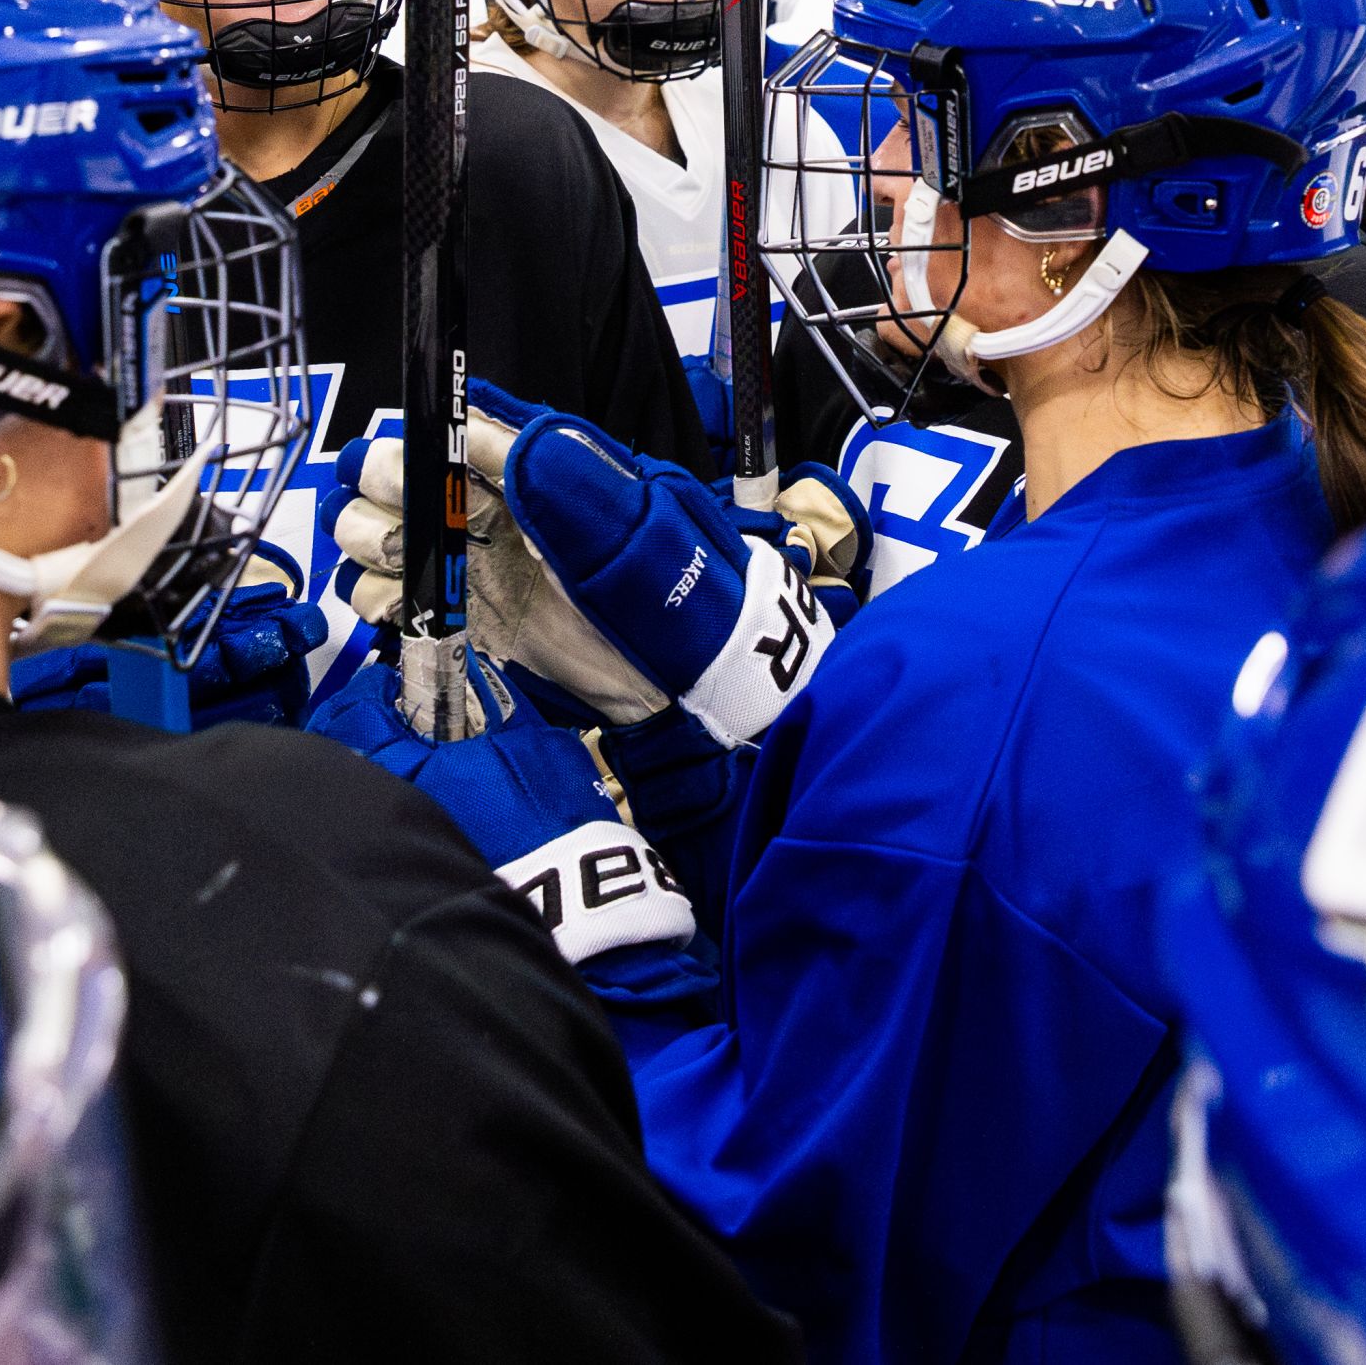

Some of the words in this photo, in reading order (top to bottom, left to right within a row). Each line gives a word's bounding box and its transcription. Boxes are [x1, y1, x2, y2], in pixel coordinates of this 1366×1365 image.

[454, 67, 468, 116] P28
[731, 180, 746, 280] BAUER
[452, 349, 467, 419] PRO
[664, 544, 709, 609] LAKERS
